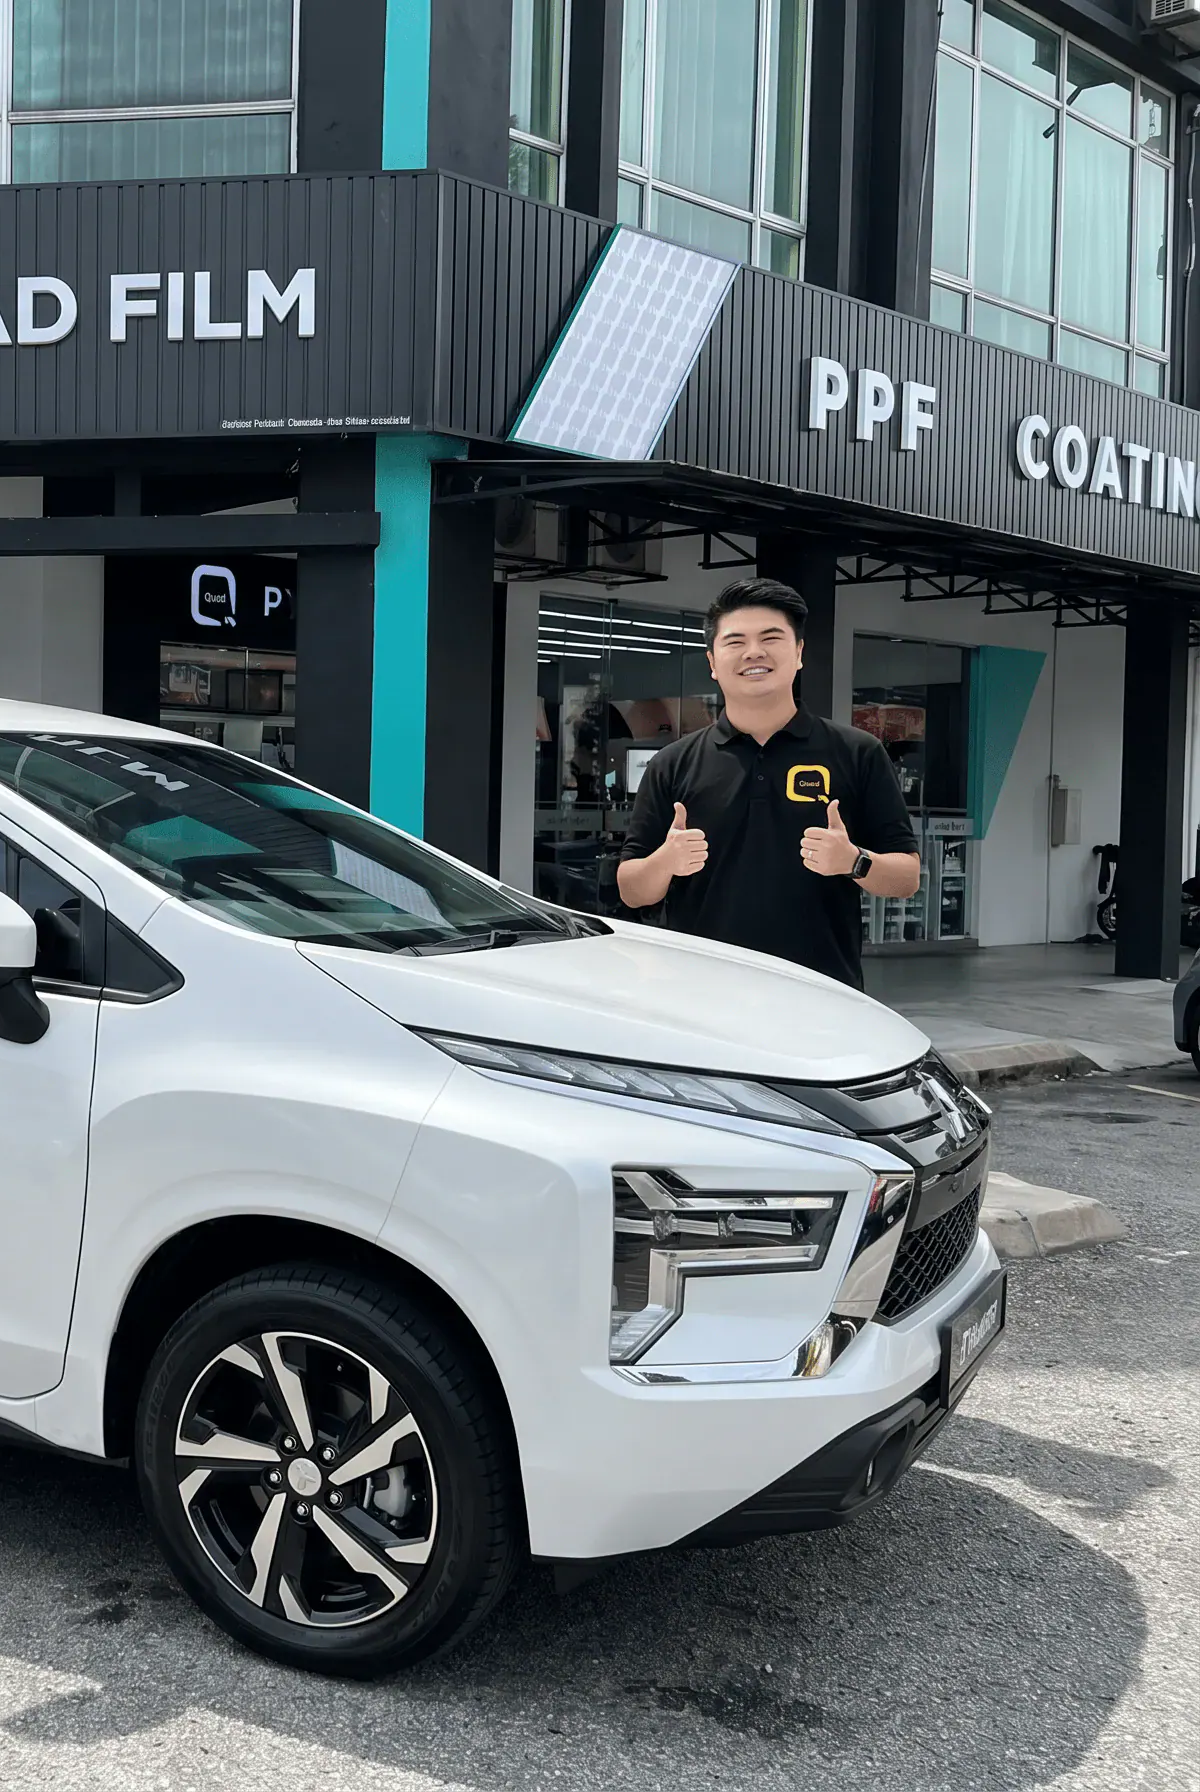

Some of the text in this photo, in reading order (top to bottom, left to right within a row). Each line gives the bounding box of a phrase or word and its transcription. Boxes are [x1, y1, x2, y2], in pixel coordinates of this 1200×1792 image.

[109, 267, 316, 343] FILM
[808, 356, 1200, 523] PPF COATIN
